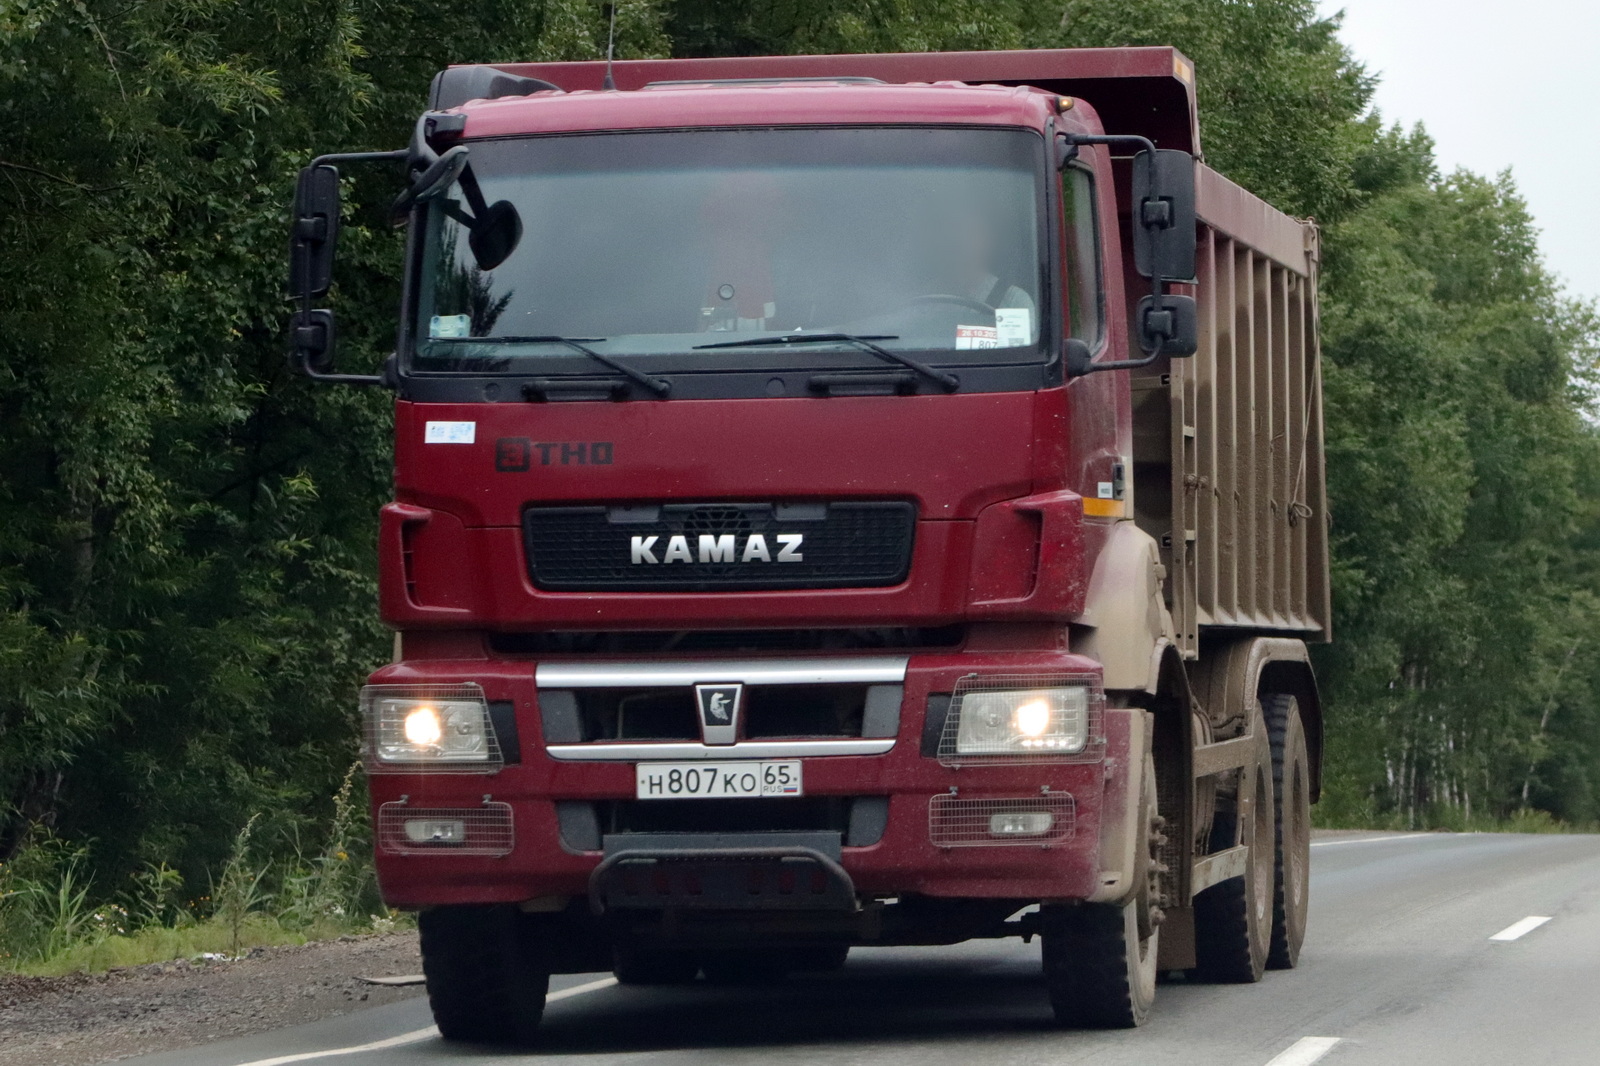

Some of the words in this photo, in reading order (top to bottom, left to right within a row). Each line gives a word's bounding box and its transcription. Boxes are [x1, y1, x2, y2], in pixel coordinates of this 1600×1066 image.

[631, 534, 803, 564] KAMAZ
[764, 765, 790, 785] 65
[763, 785, 782, 793] RUS
